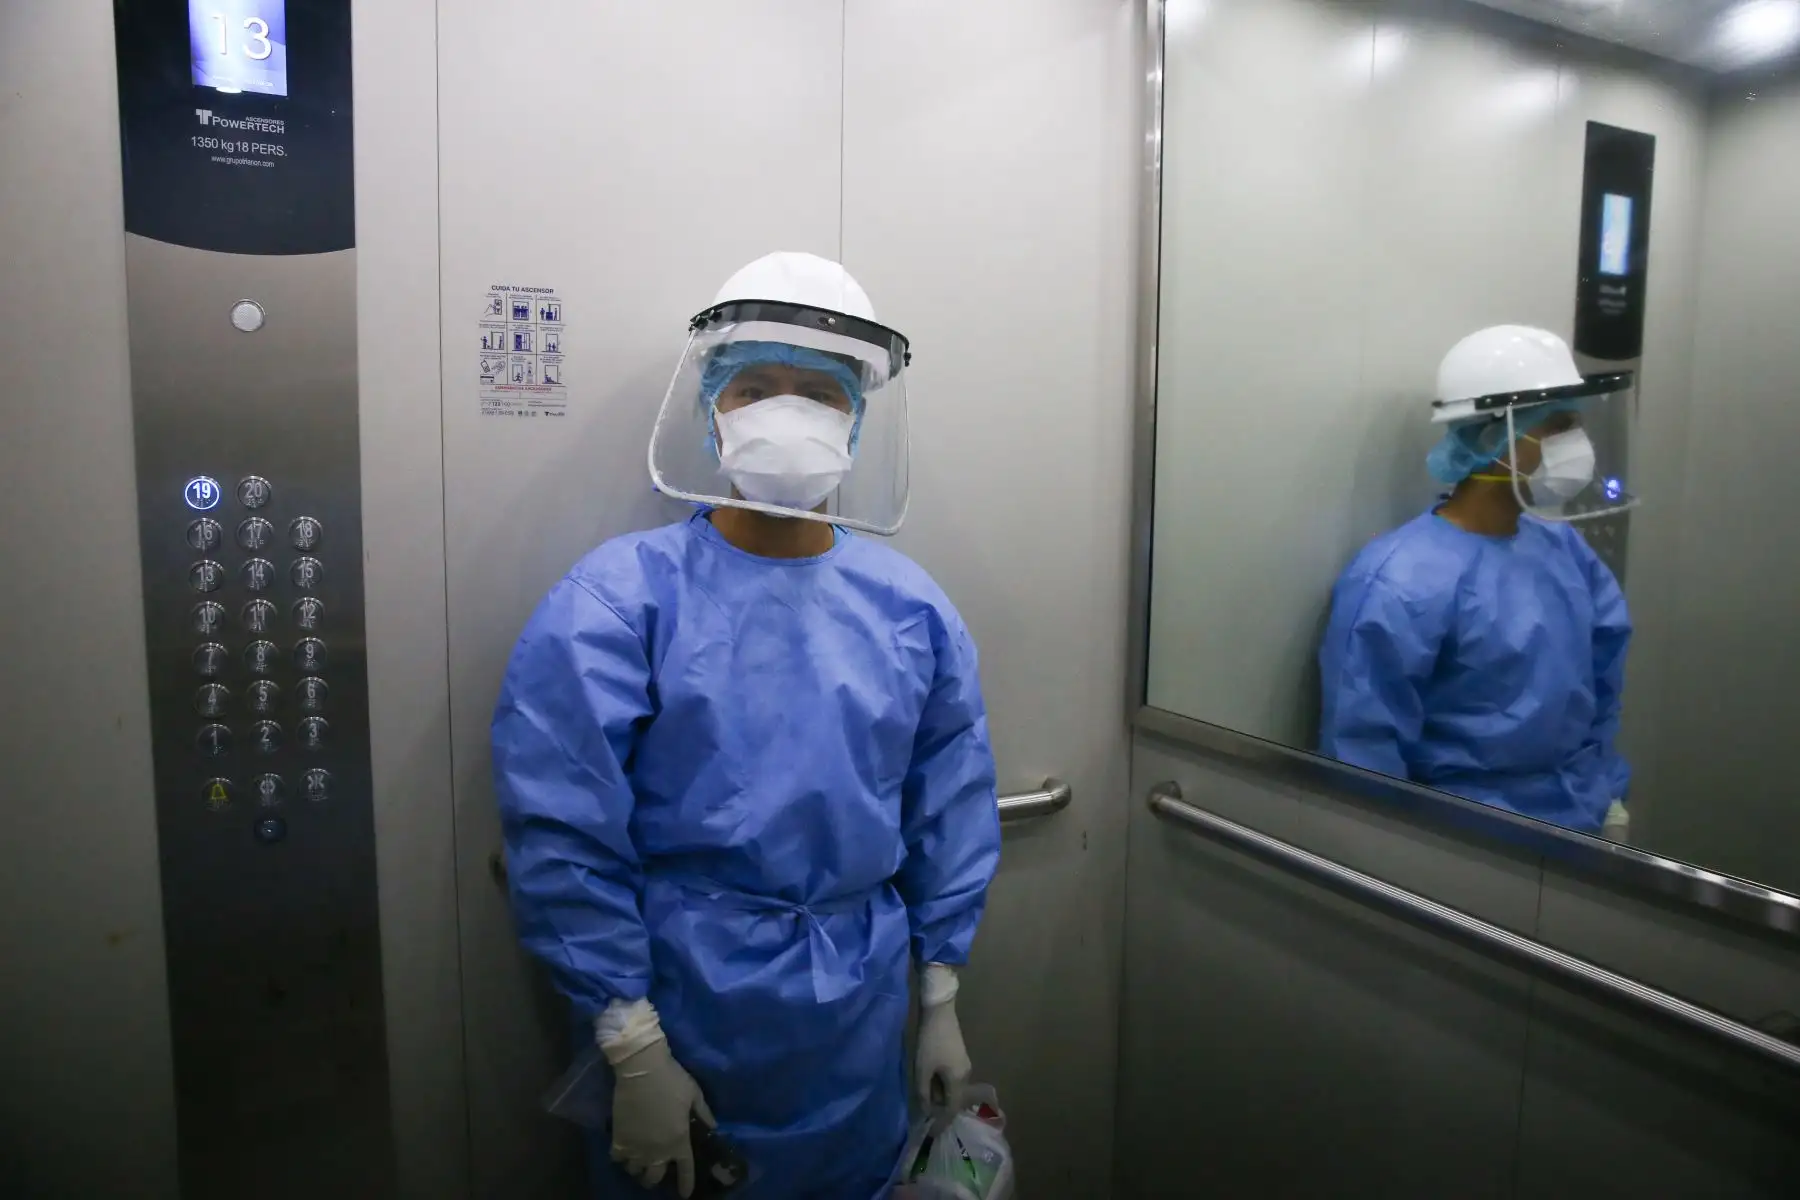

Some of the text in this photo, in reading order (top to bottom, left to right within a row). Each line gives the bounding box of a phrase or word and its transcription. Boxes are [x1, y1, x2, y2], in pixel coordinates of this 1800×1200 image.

[212, 13, 273, 61] 13
[212, 116, 285, 134] POWERTECH
[245, 116, 285, 126] ASCENSORES
[191, 136, 288, 157] 1350 kg 18 PERS.
[192, 482, 211, 499] 19
[245, 482, 262, 498] 20
[195, 524, 213, 541] 16
[246, 523, 263, 539] 17
[295, 522, 313, 538] 18
[196, 566, 215, 582] 13
[248, 565, 265, 580] 14
[297, 563, 314, 579] 15
[198, 607, 216, 623] 10
[250, 605, 266, 621] 11
[299, 603, 316, 619] 12
[205, 648, 214, 665] 7
[256, 646, 265, 662] 8
[305, 643, 314, 659] 9
[207, 690, 217, 705] 4
[259, 687, 268, 702] 5
[307, 683, 316, 698] 6
[210, 730, 218, 745] 1
[261, 726, 270, 742] 2
[309, 722, 318, 738] 3
